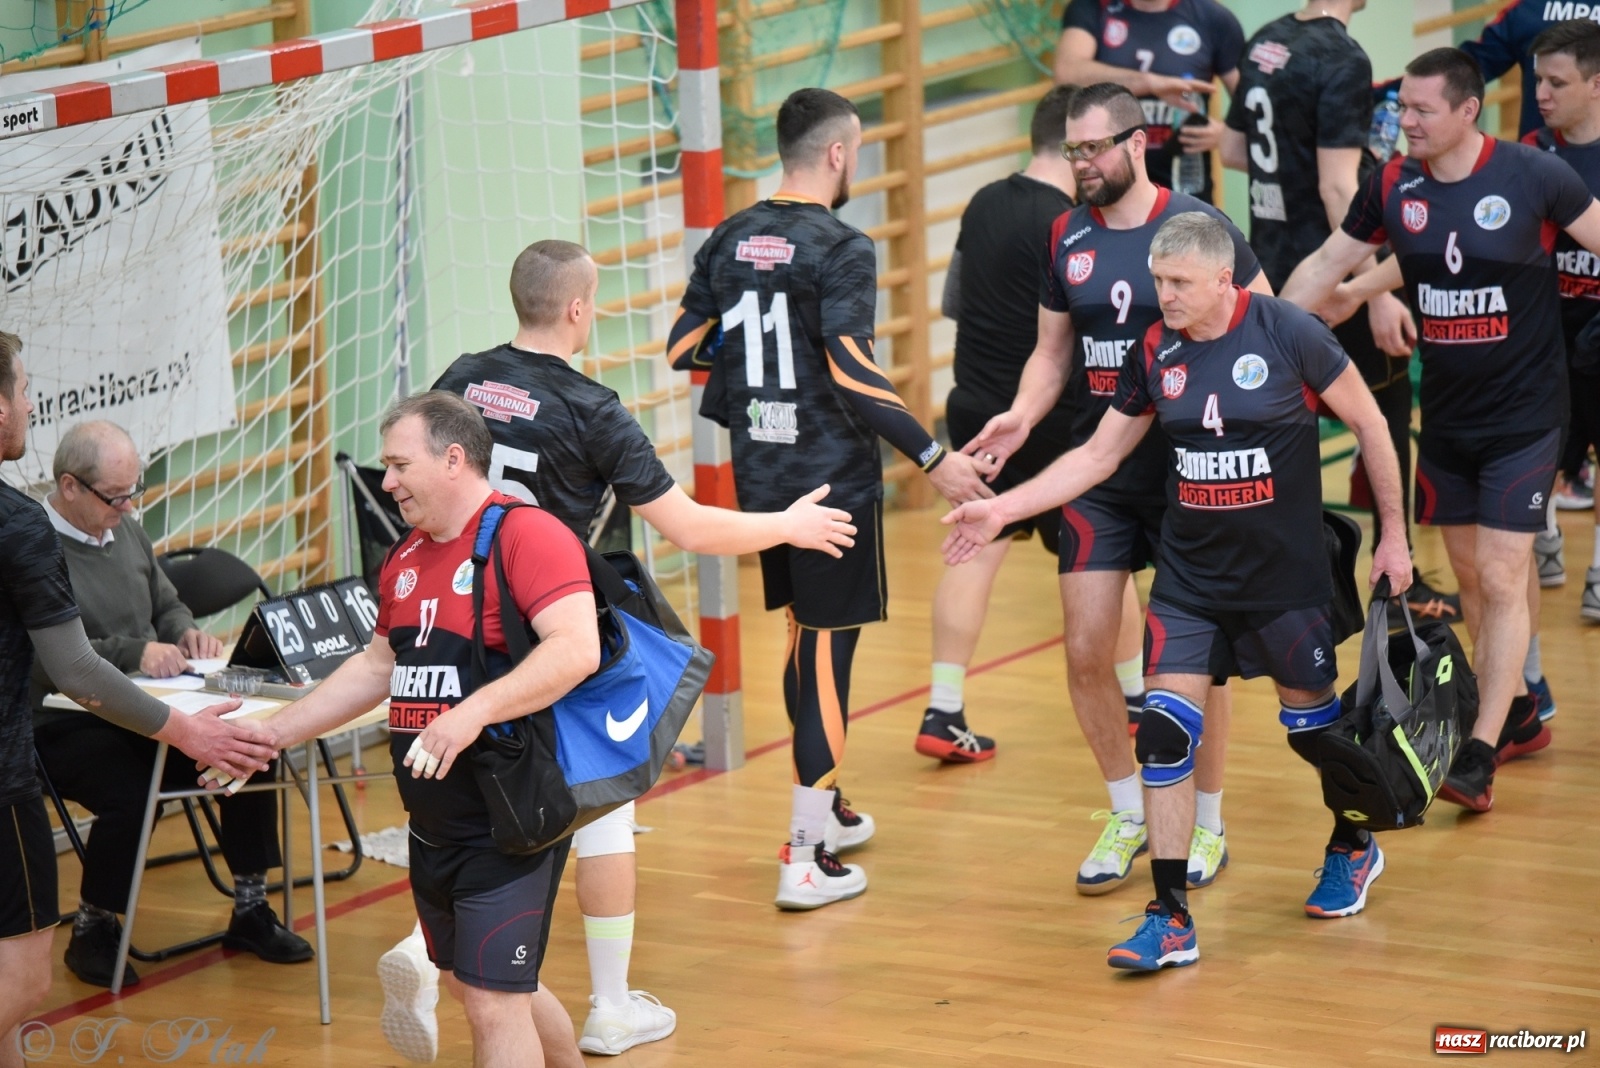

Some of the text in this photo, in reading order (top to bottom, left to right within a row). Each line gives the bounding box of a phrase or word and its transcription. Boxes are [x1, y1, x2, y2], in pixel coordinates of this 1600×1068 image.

[1136, 49, 1154, 72] 7
[3, 106, 39, 131] sport
[1245, 87, 1279, 173] 3
[1445, 231, 1463, 275] 6
[1111, 280, 1132, 324] 9
[1418, 283, 1508, 316] OMERTA
[722, 290, 797, 389] 11
[1082, 336, 1136, 367] OME
[470, 389, 531, 414] PIWIARNIA
[1203, 394, 1224, 437] 4
[488, 442, 540, 507] 5
[1174, 447, 1272, 480] OMERTA
[266, 586, 379, 656] 25 0 0 16
[415, 598, 439, 647] 11
[312, 634, 349, 656] JOOLA
